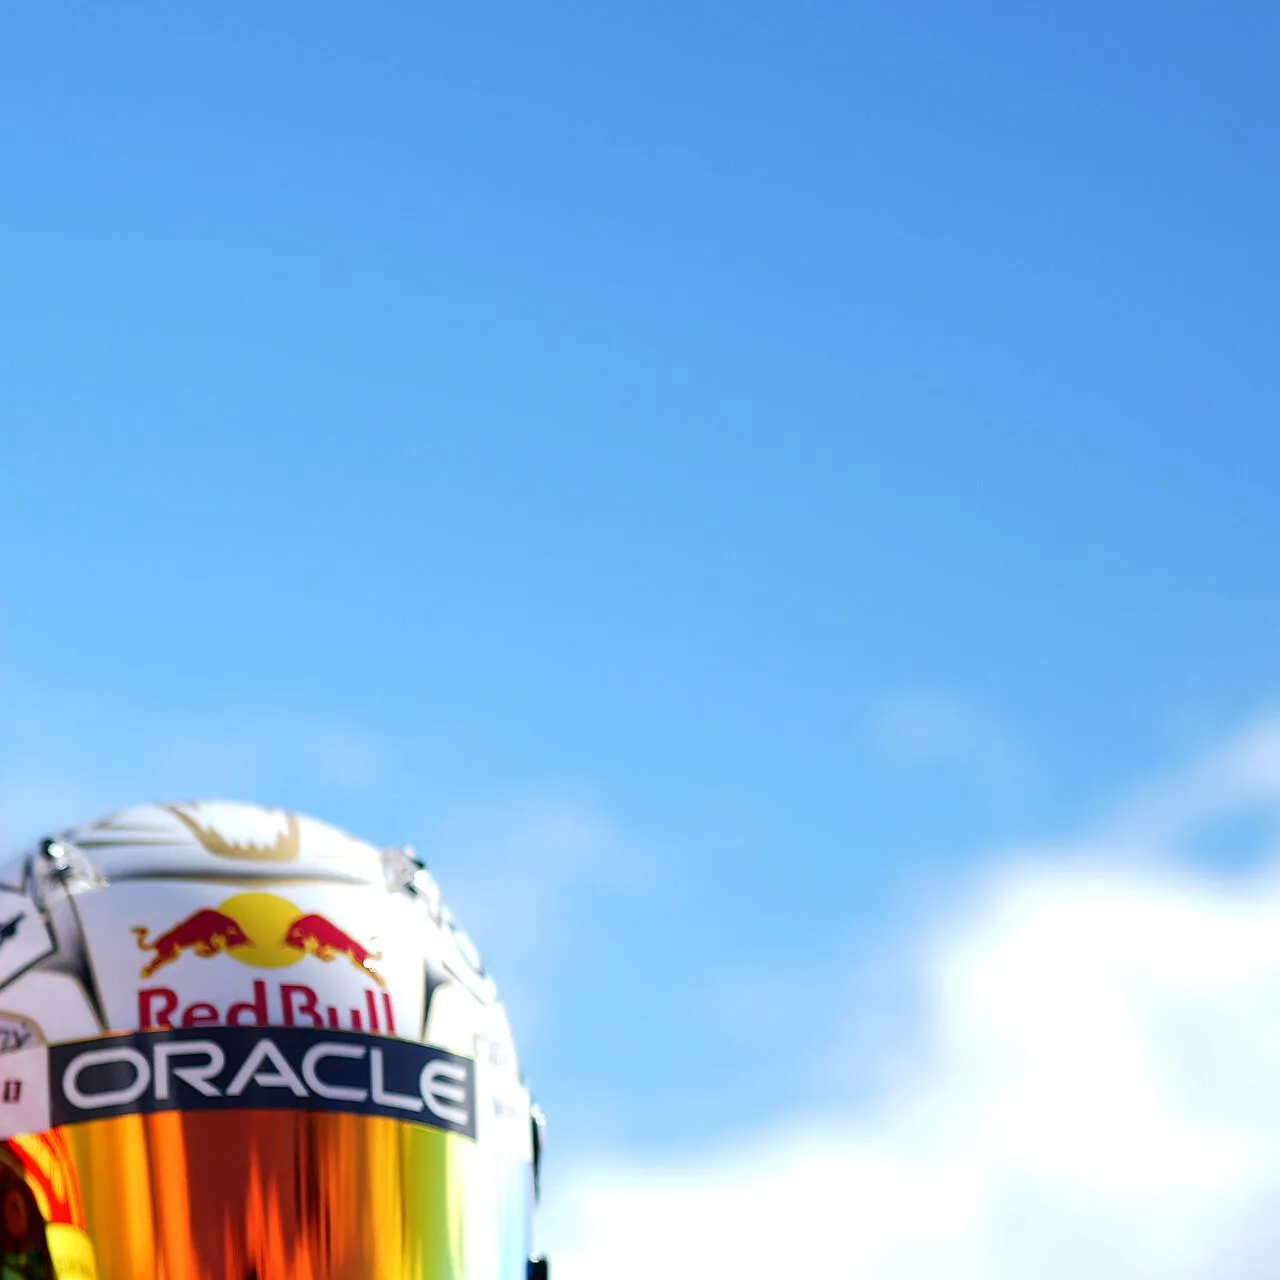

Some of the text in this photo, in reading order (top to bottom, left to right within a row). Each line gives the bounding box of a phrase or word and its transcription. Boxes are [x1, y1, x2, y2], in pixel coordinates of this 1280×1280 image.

[137, 981, 397, 1038] Red Bull
[62, 1038, 469, 1126] ORACLE
